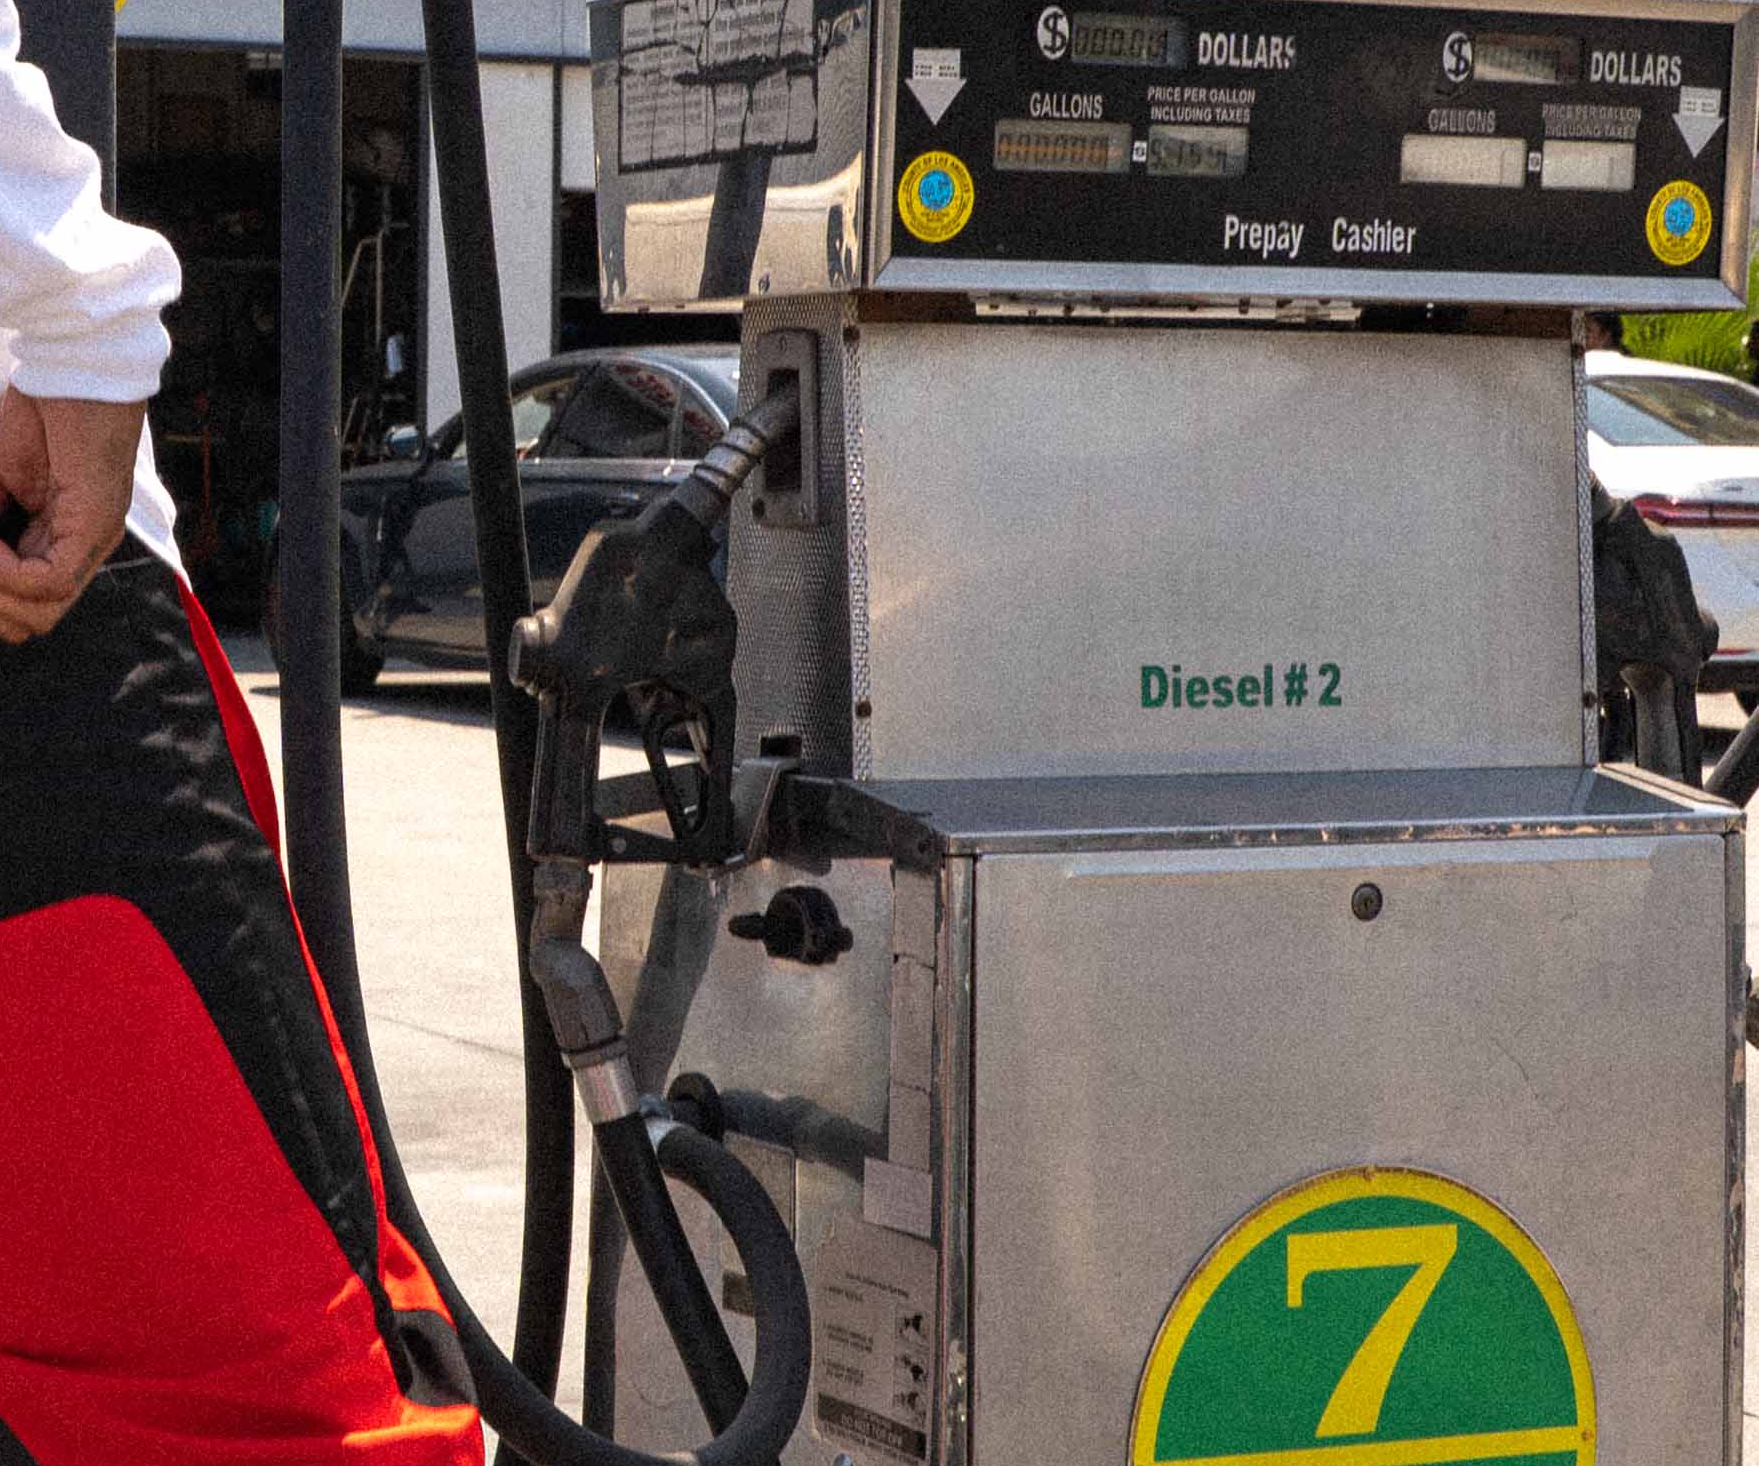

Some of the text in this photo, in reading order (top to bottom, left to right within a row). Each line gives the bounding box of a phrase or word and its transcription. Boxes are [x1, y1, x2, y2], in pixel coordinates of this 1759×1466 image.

[1198, 31, 1297, 70] DOLLARS
[1590, 50, 1682, 87] DOLLARS
[1029, 90, 1104, 120] GALLONS
[1147, 86, 1256, 105] PRICE PER GALLON
[1150, 106, 1251, 124] INCLUDING TAXES
[1427, 107, 1496, 134] GALLONS
[1223, 214, 1417, 259] Prepay Cashier
[1141, 663, 1273, 709] Diesel
[1286, 1223, 1458, 1438] 7
